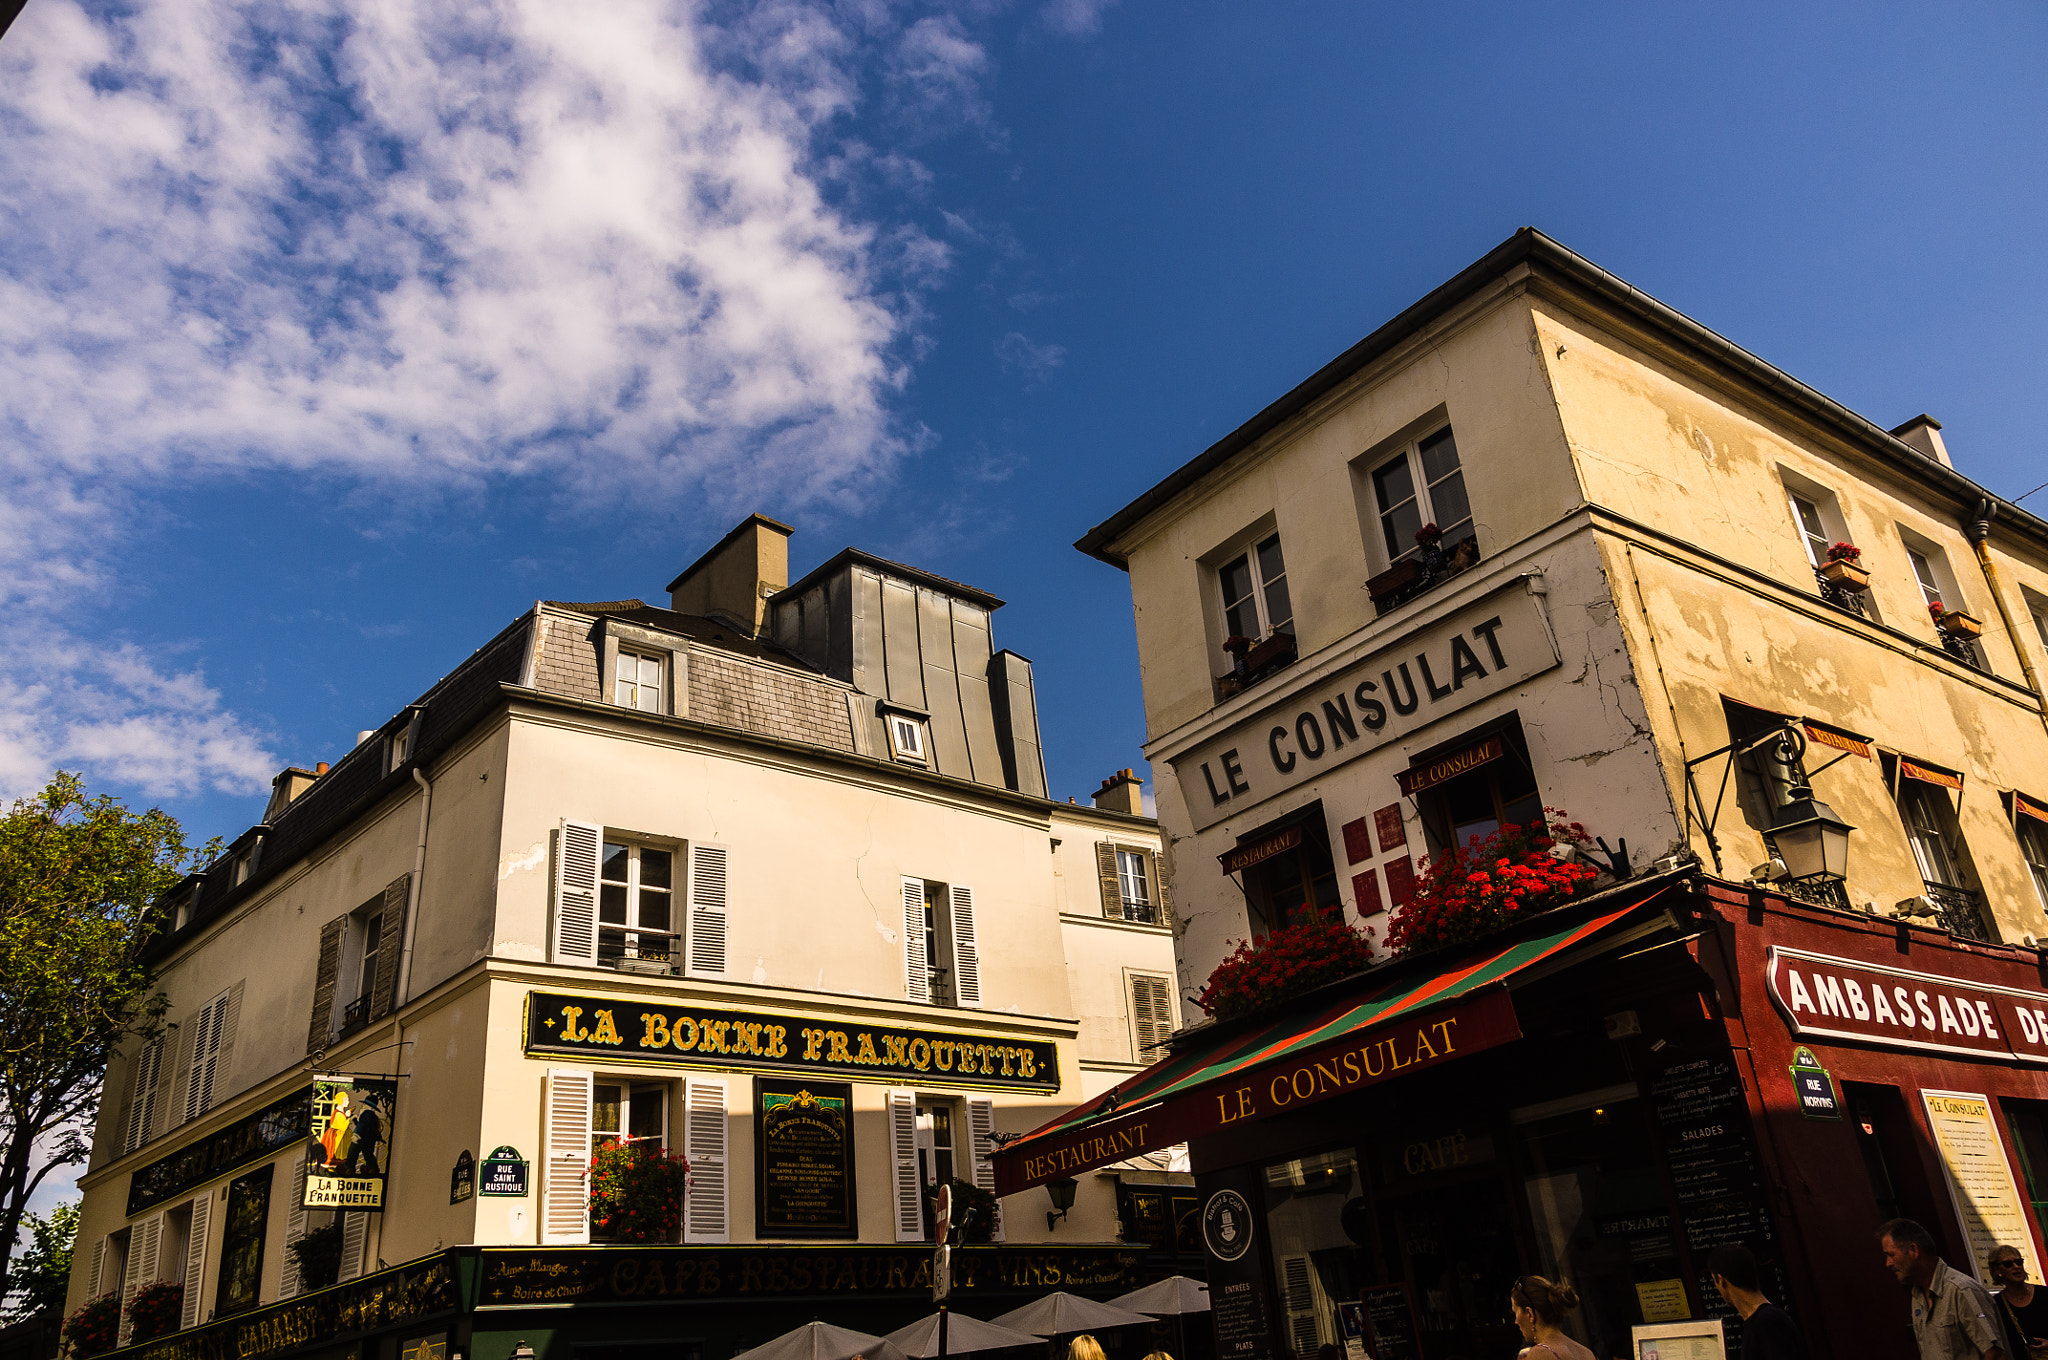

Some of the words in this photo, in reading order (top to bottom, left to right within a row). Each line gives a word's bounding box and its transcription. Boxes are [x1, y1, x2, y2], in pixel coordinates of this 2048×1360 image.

[1201, 747, 1249, 808] LE
[1269, 615, 1508, 776] CONSULAT
[1410, 774, 1424, 790] LE
[1430, 743, 1491, 783] CONSULAT
[1231, 834, 1291, 870] RESTAURANT
[1788, 969, 1999, 1039] AMBASSADE
[560, 1006, 623, 1045] LA
[640, 1013, 788, 1058] BONNE
[801, 1028, 1037, 1078] FRANQUETTE
[1217, 1086, 1255, 1124] LE
[1270, 1017, 1458, 1106] CONSULAT
[1806, 1079, 1822, 1091] RUE
[1803, 1095, 1833, 1109] NORVINS
[1932, 1099, 1943, 1113] LE
[1944, 1099, 1984, 1116] CONSULAT
[1682, 1124, 1724, 1141] SALADES
[1024, 1122, 1148, 1181] RESTAURANT
[493, 1173, 516, 1183] SAINT
[497, 1165, 513, 1174] RUE
[317, 1178, 331, 1190] LA
[337, 1179, 373, 1191] BONNE
[484, 1182, 523, 1192] RUSTIQUE
[308, 1190, 379, 1204] FRANQUETTE
[609, 1255, 721, 1297] CAFÉ
[1000, 1254, 1062, 1287] VINS
[512, 1284, 543, 1299] Boire
[544, 1289, 556, 1299] et
[236, 1304, 320, 1358] CABARET
[1235, 1341, 1254, 1351] PLATS
